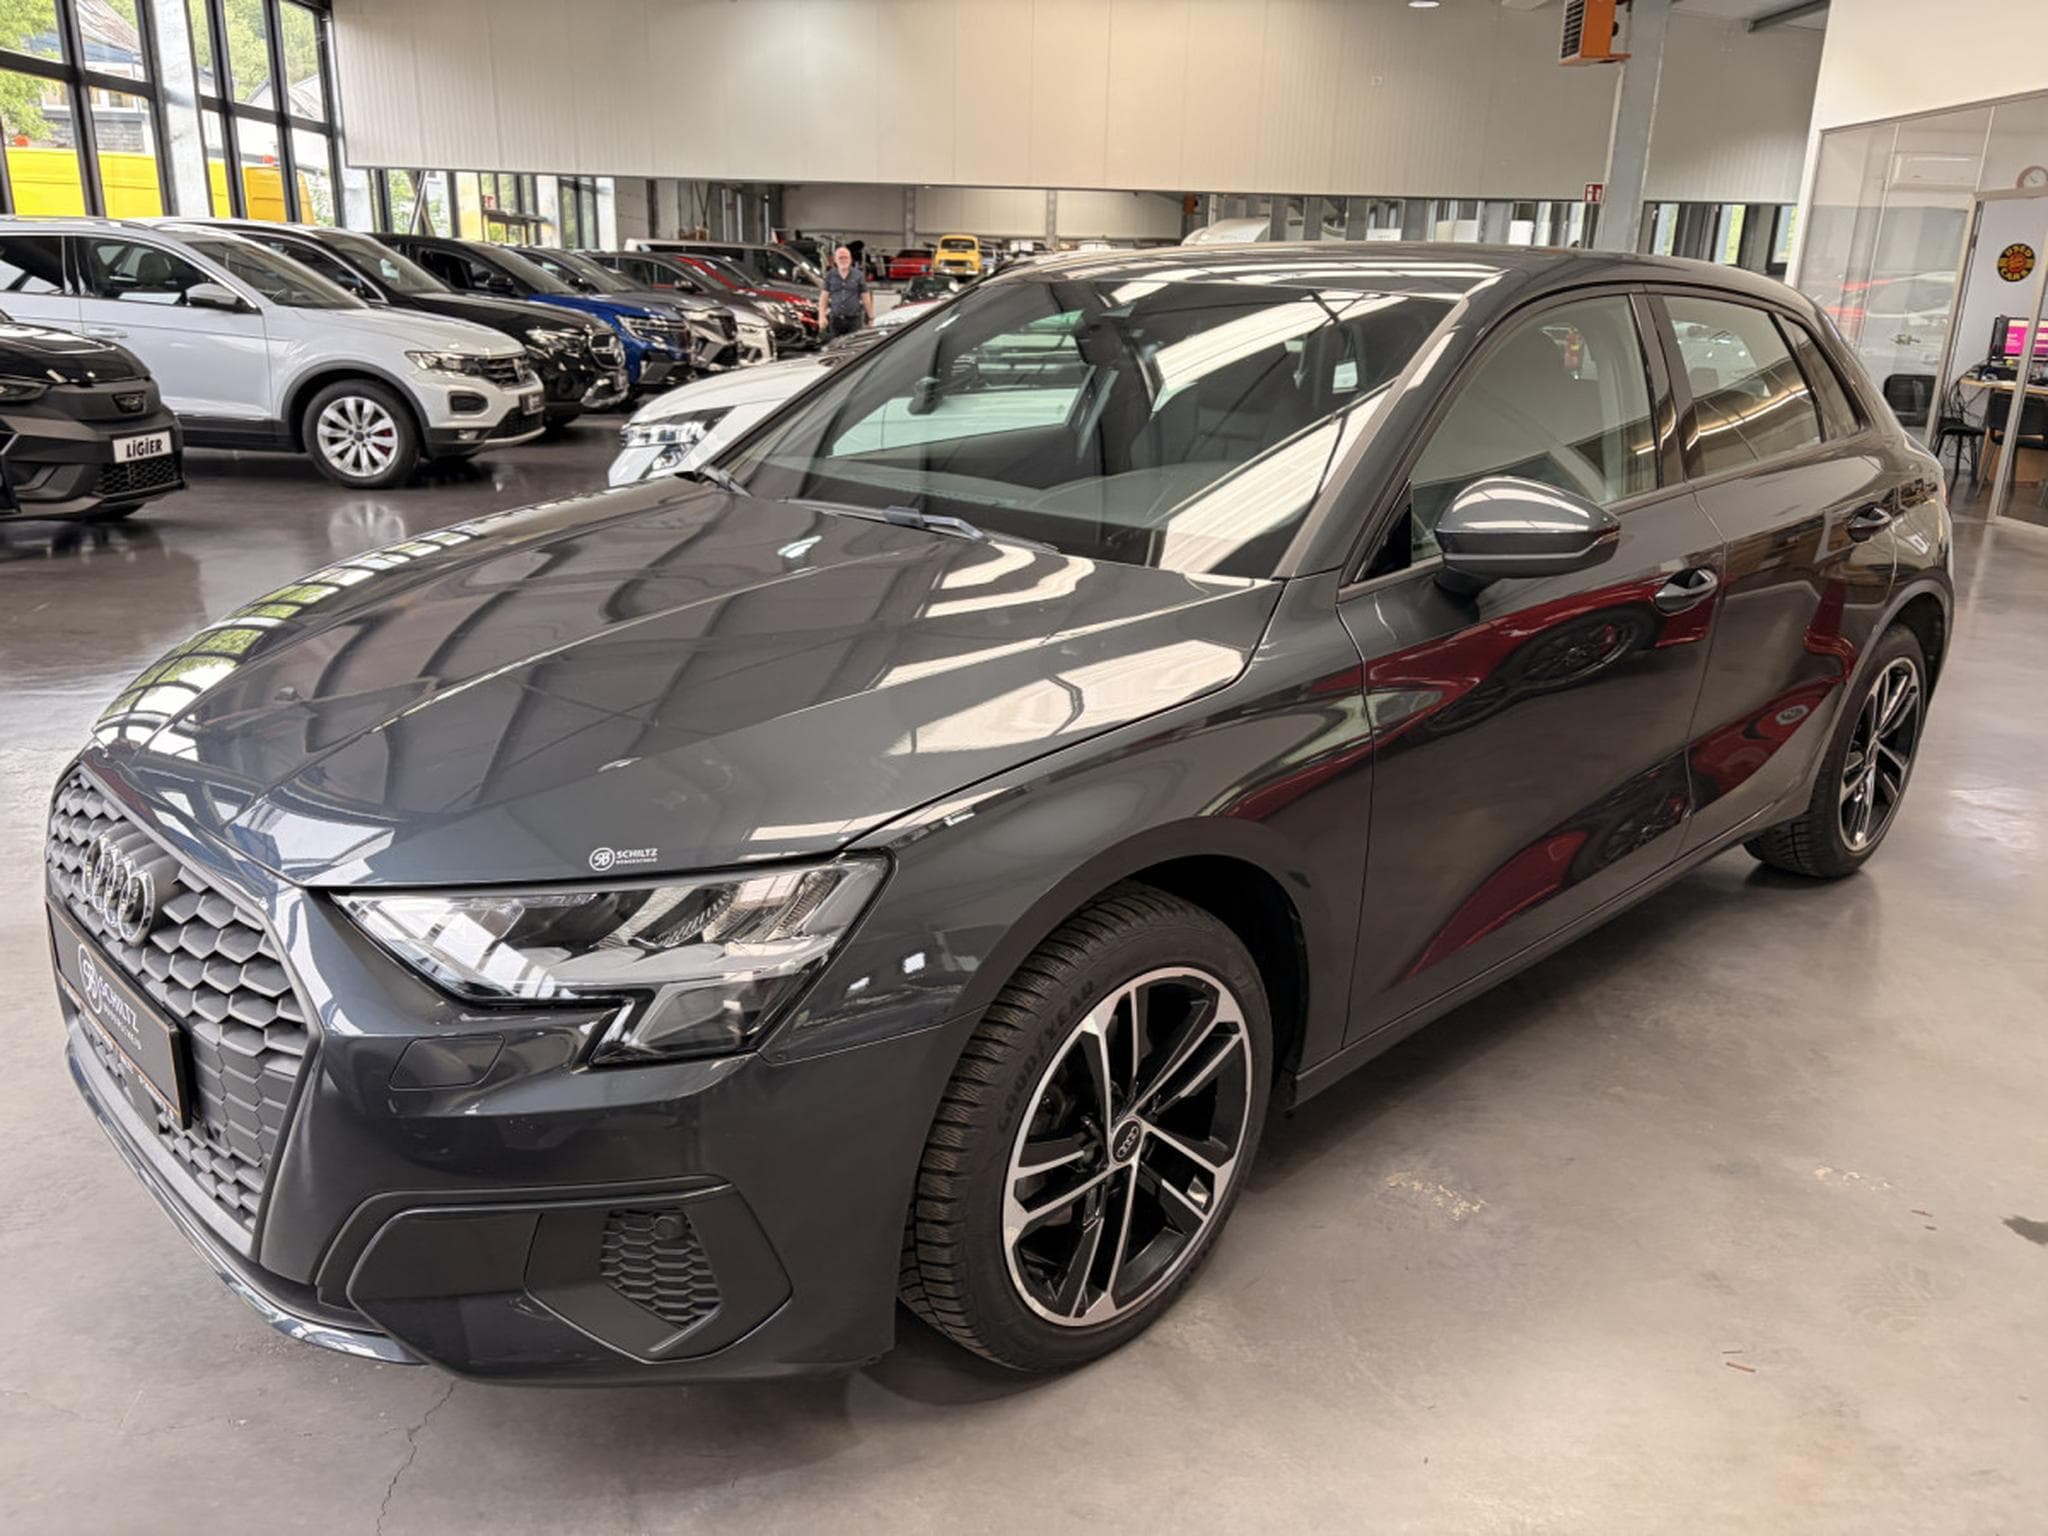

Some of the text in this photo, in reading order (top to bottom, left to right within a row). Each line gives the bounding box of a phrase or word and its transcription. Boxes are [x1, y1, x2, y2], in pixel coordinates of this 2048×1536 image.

[2005, 245, 2033, 257] USED
[2000, 268, 2029, 281] CARS
[616, 848, 658, 859] SCHILTZ
